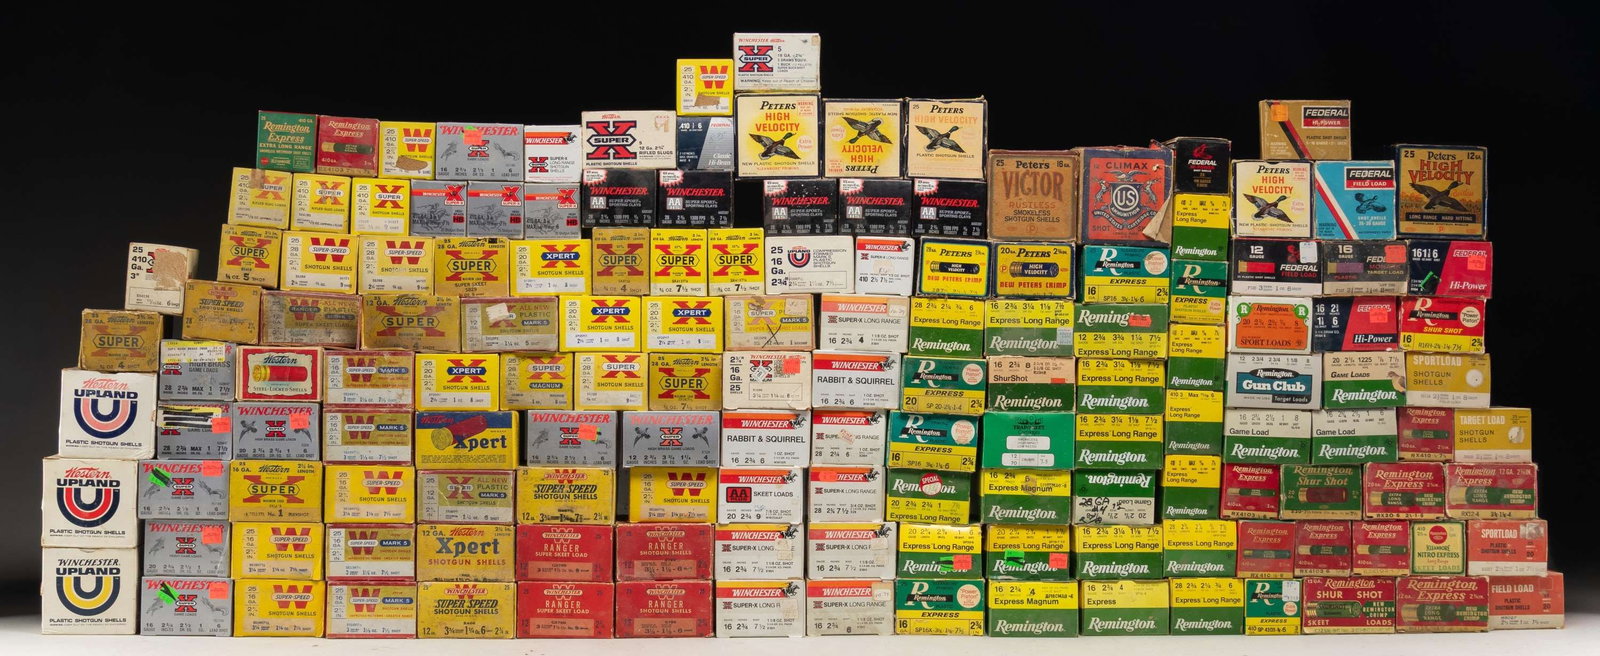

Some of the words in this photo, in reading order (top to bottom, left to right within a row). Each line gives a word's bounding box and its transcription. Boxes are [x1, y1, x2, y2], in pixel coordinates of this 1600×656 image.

[939, 116, 978, 124] VELOCITY
[264, 122, 310, 132] Remington
[329, 121, 370, 130] Remington
[755, 122, 800, 132] VELOCITY
[335, 129, 363, 137] Express
[268, 133, 304, 143] Express
[842, 145, 882, 153] VELOCITY
[1105, 162, 1148, 170] CLIMAX
[1420, 160, 1462, 171] HIGH
[1262, 176, 1284, 184] HIGH
[1408, 170, 1474, 185] VELOCITY
[1001, 171, 1063, 201] VICTOR
[1252, 186, 1293, 194] VELOCITY
[590, 187, 648, 195] WINCHESTER
[667, 188, 724, 196] WINCHESTER
[772, 197, 830, 205] WINCHESTER
[1118, 189, 1135, 204] US
[921, 198, 979, 207] WINCHESTER
[1111, 208, 1140, 218] AMMUNITION
[234, 248, 265, 256] SUPER
[1176, 247, 1217, 256] Remington
[1338, 245, 1352, 253] 16
[603, 255, 637, 265] SUPER
[661, 256, 694, 265] SUPER
[719, 255, 752, 265] SUPER
[453, 261, 490, 270] SUPER
[771, 267, 785, 275] Ga.
[1449, 281, 1487, 290] Hi-Power
[386, 317, 434, 326] SUPER
[99, 337, 138, 347] SUPER
[989, 336, 1057, 351] Remington
[1241, 338, 1263, 346] SPORT
[1265, 338, 1291, 346] LOADS
[1354, 335, 1393, 343] Hi-Power
[912, 338, 970, 351] Remington
[832, 361, 879, 369] WINCHESTER
[1413, 356, 1461, 365] SPORTLOAD
[1257, 370, 1294, 378] Remington
[1114, 375, 1132, 383] Long
[1171, 377, 1212, 386] Remington
[665, 380, 702, 388] SUPER
[1242, 381, 1272, 390] Gun
[1274, 381, 1305, 392] Club
[74, 389, 138, 399] UPLAND
[1333, 389, 1397, 402] Remington
[995, 395, 1062, 409] Remington
[1081, 394, 1148, 408] Remington
[532, 413, 609, 422] WINCHESTER
[631, 415, 713, 425] WINCHESTER
[1460, 416, 1486, 424] TARGET
[1488, 415, 1505, 424] LOAD
[741, 420, 789, 428] WINCHESTER
[454, 434, 506, 451] Xpert
[1169, 441, 1210, 450] Remington
[1232, 443, 1298, 458] Remington
[1321, 444, 1385, 458] Remington
[1079, 450, 1146, 464] Remington
[1376, 470, 1433, 479] Remington
[1455, 468, 1495, 476] Remington
[57, 478, 120, 487] UPLAND
[739, 475, 781, 483] WINCHESTER
[1089, 476, 1152, 488] Remington
[1457, 477, 1492, 485] Express
[1384, 480, 1423, 488] Express
[252, 485, 295, 493] SUPER
[535, 485, 564, 493] SUPER
[567, 485, 597, 493] SPEED
[731, 489, 747, 498] AA
[989, 506, 1056, 520] Remington
[1165, 506, 1207, 515] Remington
[1481, 529, 1517, 539] SPORTLOAD
[436, 538, 500, 557] Xpert
[544, 544, 579, 552] RANGER
[648, 542, 683, 550] RANGER
[1083, 561, 1149, 575] Remington
[1168, 561, 1224, 572] Remington
[1325, 578, 1375, 588] Remington
[1408, 580, 1477, 590] Remington
[822, 588, 871, 596] WINCHESTER
[1492, 585, 1511, 593] FIELD
[1418, 592, 1465, 600] Express
[435, 599, 466, 608] SUPER
[469, 599, 498, 608] SPEED
[546, 600, 580, 608] RANGER
[995, 620, 1064, 634] Remington
[1089, 618, 1155, 630] Remington
[1175, 618, 1232, 629] Remington
